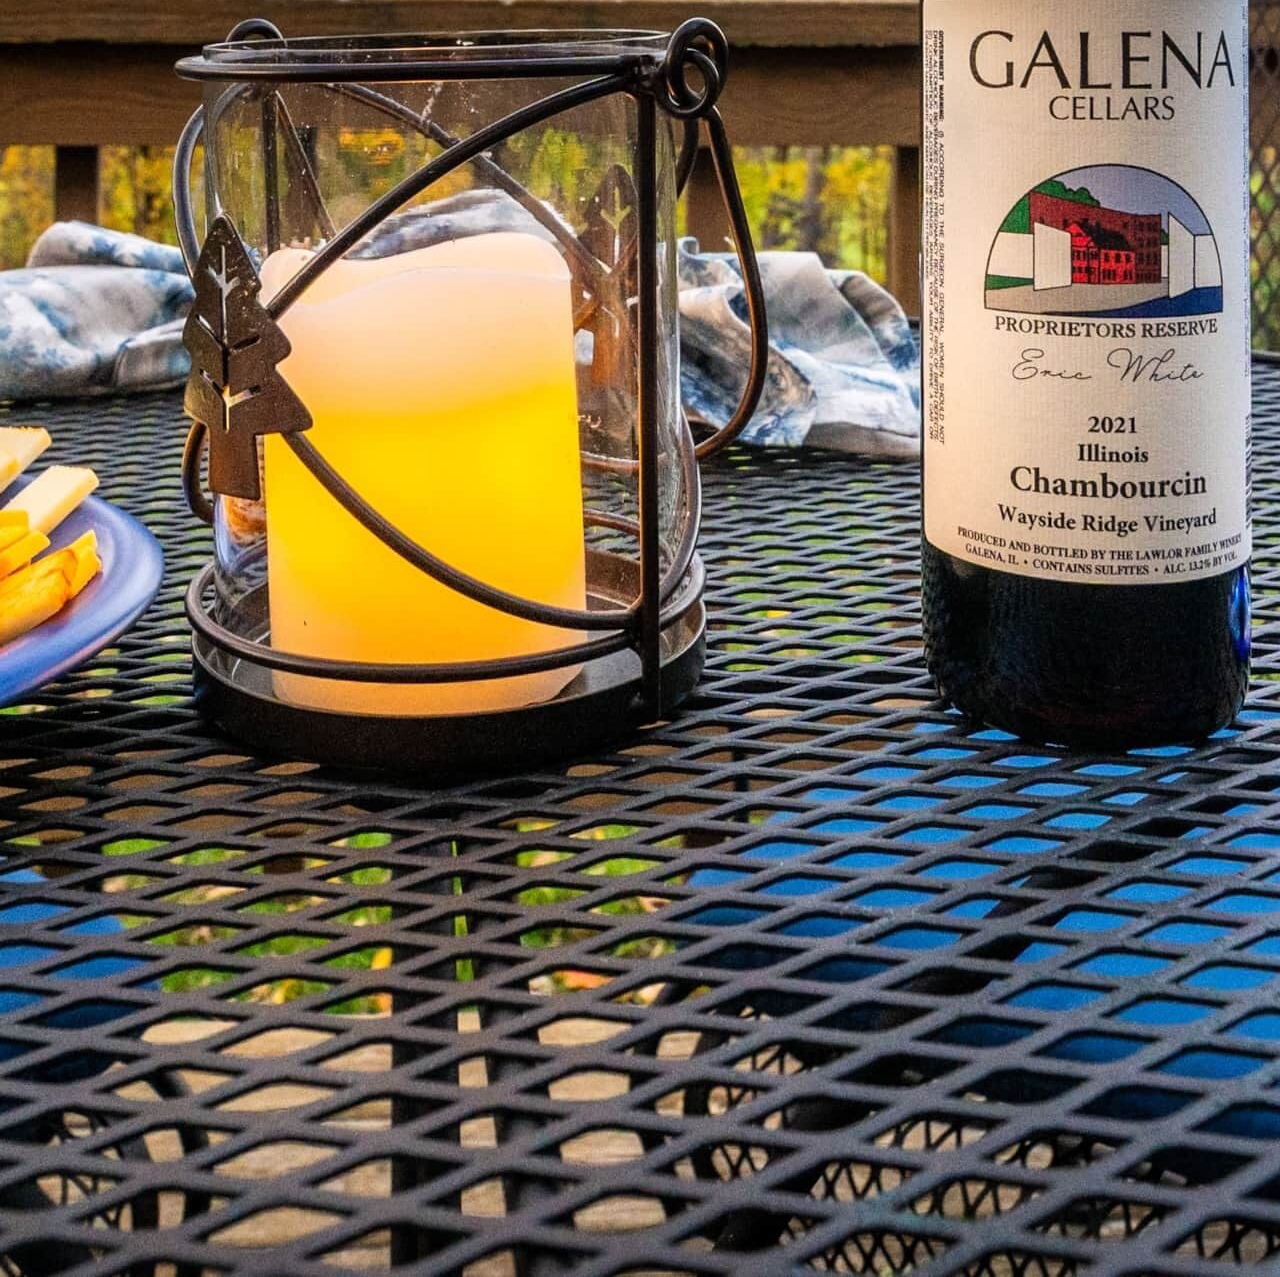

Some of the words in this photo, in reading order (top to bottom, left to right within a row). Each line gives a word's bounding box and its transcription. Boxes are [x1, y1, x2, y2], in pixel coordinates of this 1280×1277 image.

[969, 30, 1236, 89] GALENA
[1049, 96, 1175, 121] CELLARS
[939, 203, 945, 216] TO
[995, 315, 1136, 338] PROPRIETORS
[1141, 318, 1218, 338] RESERVE
[1012, 348, 1092, 380] Eric
[1107, 348, 1204, 382] White
[1087, 416, 1137, 434] 2021
[1077, 444, 1149, 463] Illinois
[1010, 466, 1207, 499] Chambourcin
[998, 504, 1077, 531] Wayside
[1081, 515, 1139, 537] Ridge
[1143, 508, 1217, 534] Vineyard
[958, 526, 1006, 547] PRODUCED
[1008, 540, 1031, 553] AND
[1033, 544, 1088, 559] BOTTLED
[1091, 549, 1106, 560] BY
[1109, 550, 1133, 561] THE
[1136, 548, 1183, 561] LAWLOR
[1184, 542, 1218, 557] FAMILY
[1033, 559, 1093, 575] CONTAINS
[1095, 564, 1150, 576] SULFITES
[1163, 563, 1186, 575] ALC.
[1212, 555, 1223, 567] BY
